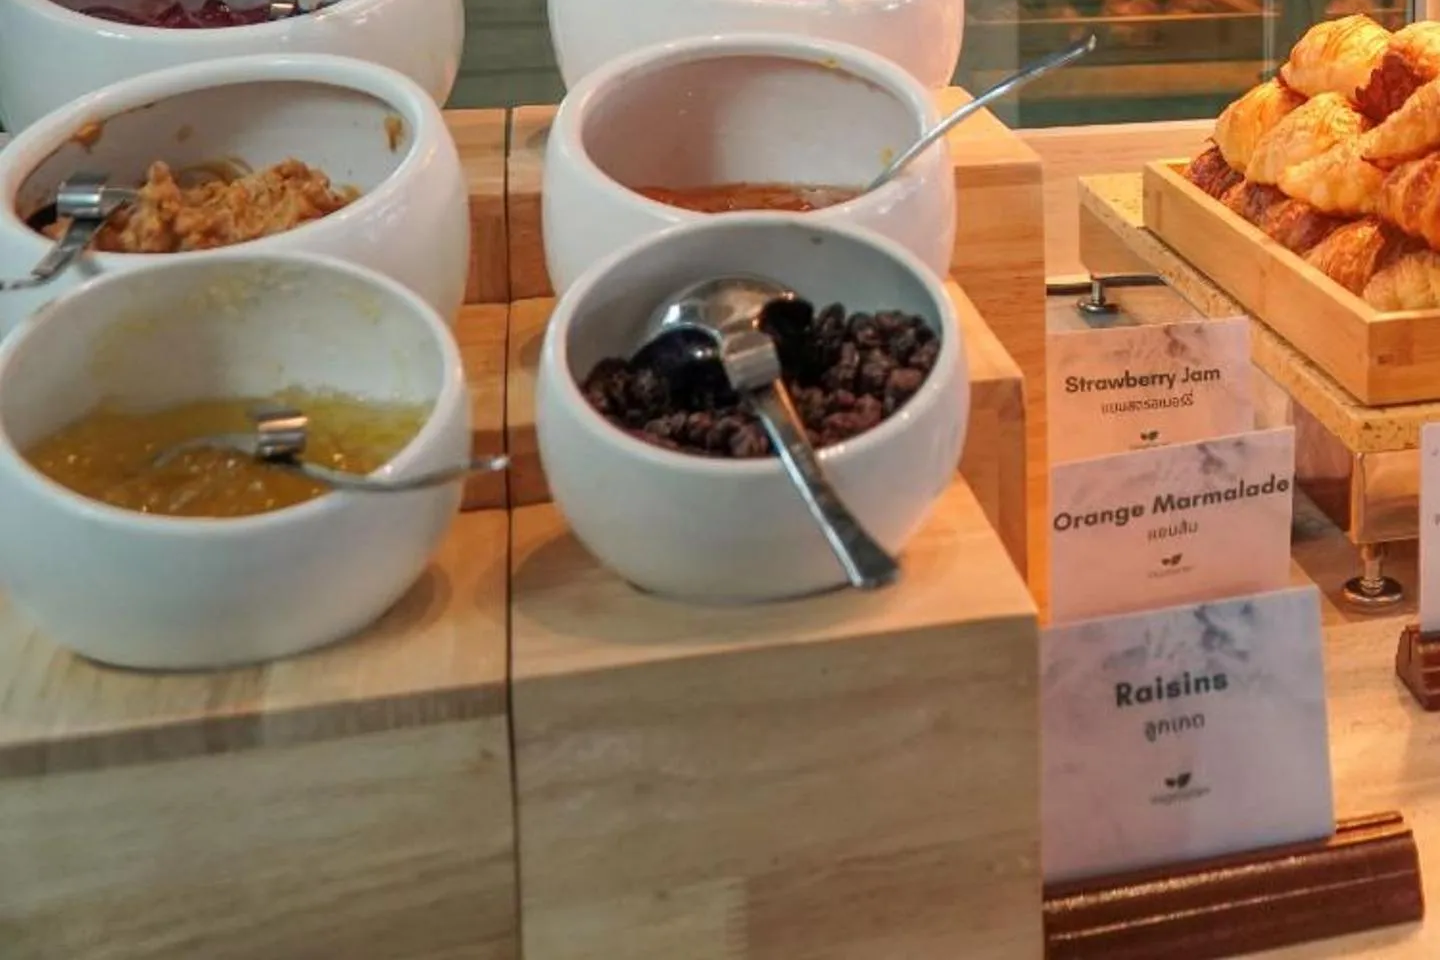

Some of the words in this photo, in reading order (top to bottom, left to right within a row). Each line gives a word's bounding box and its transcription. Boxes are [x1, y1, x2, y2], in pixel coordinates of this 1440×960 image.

[1065, 370, 1176, 393] Strawberry
[1181, 366, 1221, 384] Jam
[1053, 504, 1146, 531] Orange
[1151, 474, 1290, 515] Marmalade
[1114, 671, 1230, 708] Raisins
